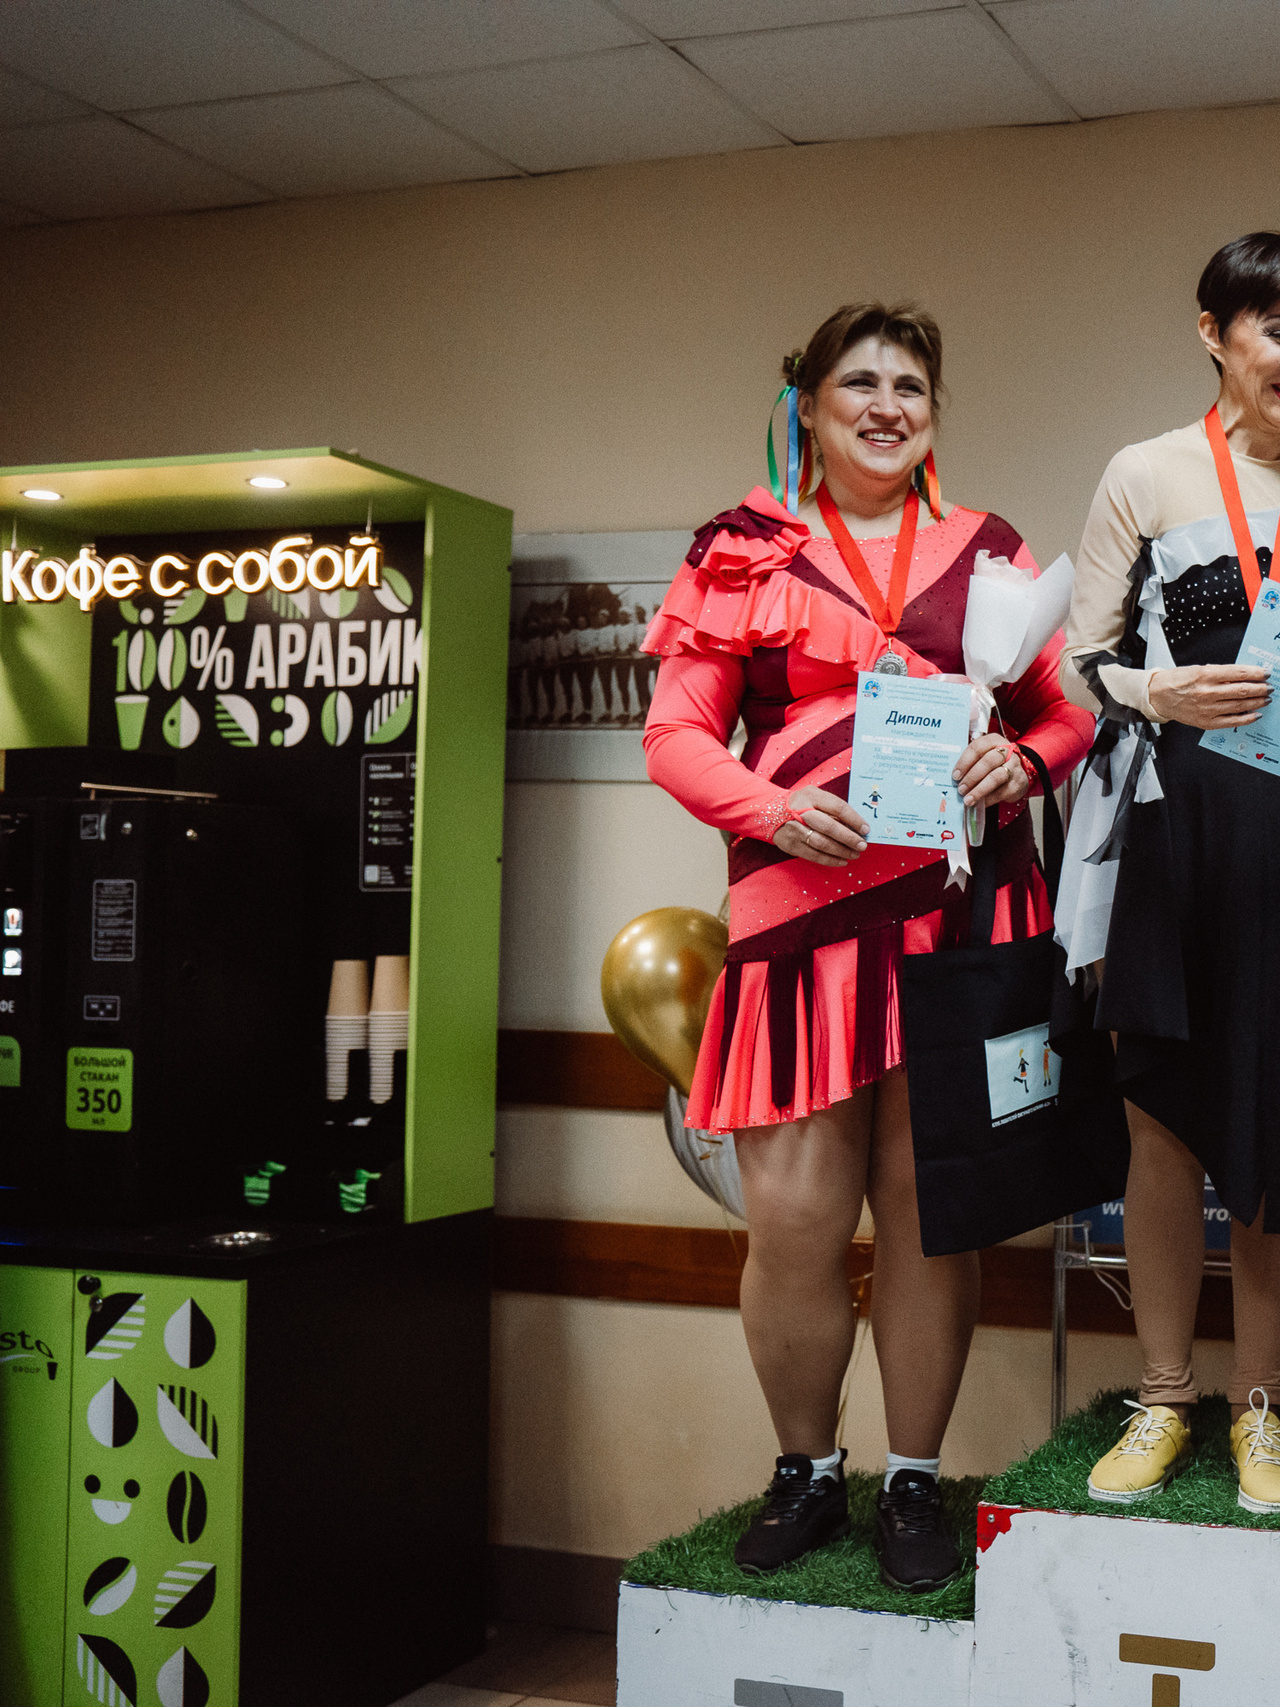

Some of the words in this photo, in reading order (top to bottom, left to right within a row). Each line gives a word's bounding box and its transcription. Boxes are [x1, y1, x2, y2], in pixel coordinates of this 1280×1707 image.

[1, 546, 142, 611] Кофе
[149, 554, 191, 597] с
[197, 534, 382, 595] собой
[112, 624, 235, 691] 100%
[885, 710, 942, 729] Диплом
[74, 1056, 126, 1067] БОЛЬШОЙ
[80, 1071, 119, 1082] СТАКАН
[76, 1087, 122, 1114] 350
